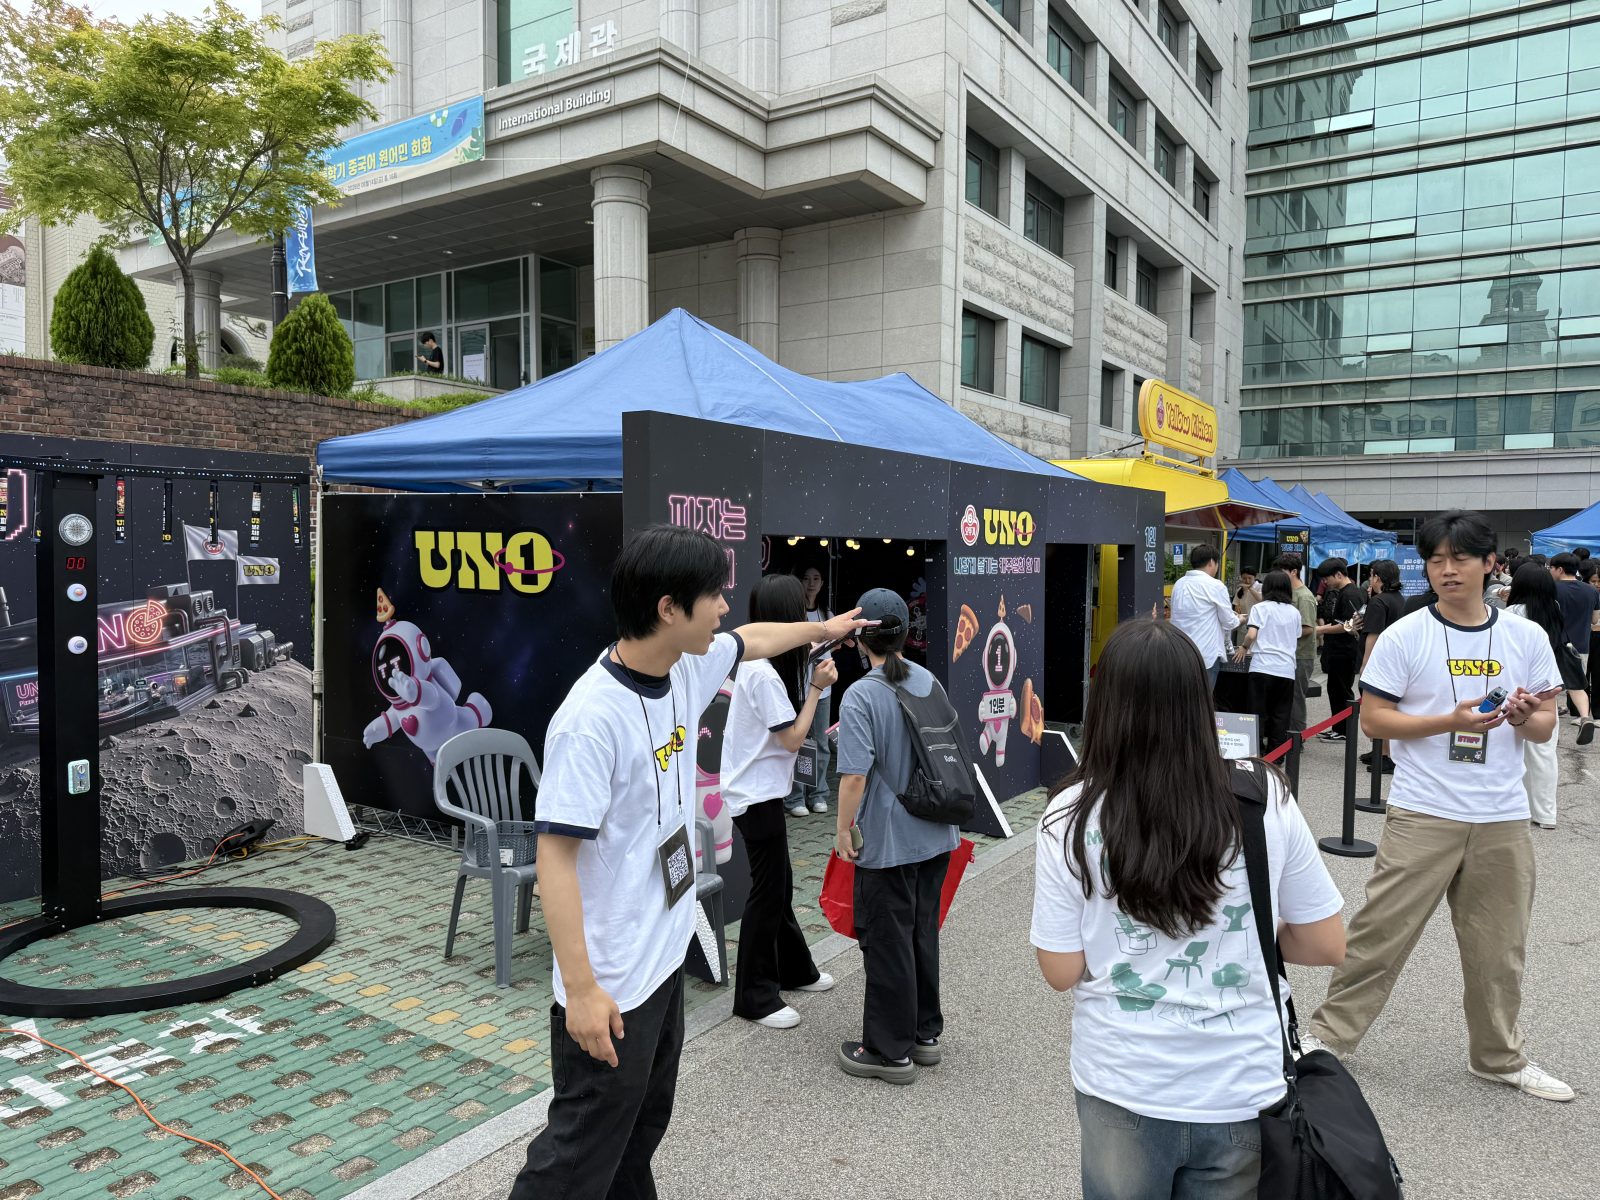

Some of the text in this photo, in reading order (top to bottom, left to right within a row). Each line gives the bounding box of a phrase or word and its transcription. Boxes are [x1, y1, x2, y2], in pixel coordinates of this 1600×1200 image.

[522, 20, 617, 75] 국제관
[498, 89, 611, 130] International Building
[348, 153, 376, 176] 중국어
[379, 143, 408, 167] 원어민
[411, 136, 432, 157] 회화
[1165, 401, 1190, 435] Yellow
[1191, 413, 1214, 443] Kitchen
[983, 508, 1034, 546] UNO
[243, 564, 275, 576] UNO
[415, 531, 556, 593] UNO
[953, 557, 976, 575] 나답게
[977, 557, 998, 575] 즐기는
[1447, 659, 1502, 676] UNO
[16, 680, 38, 699] UN
[988, 697, 1005, 715] 1인분
